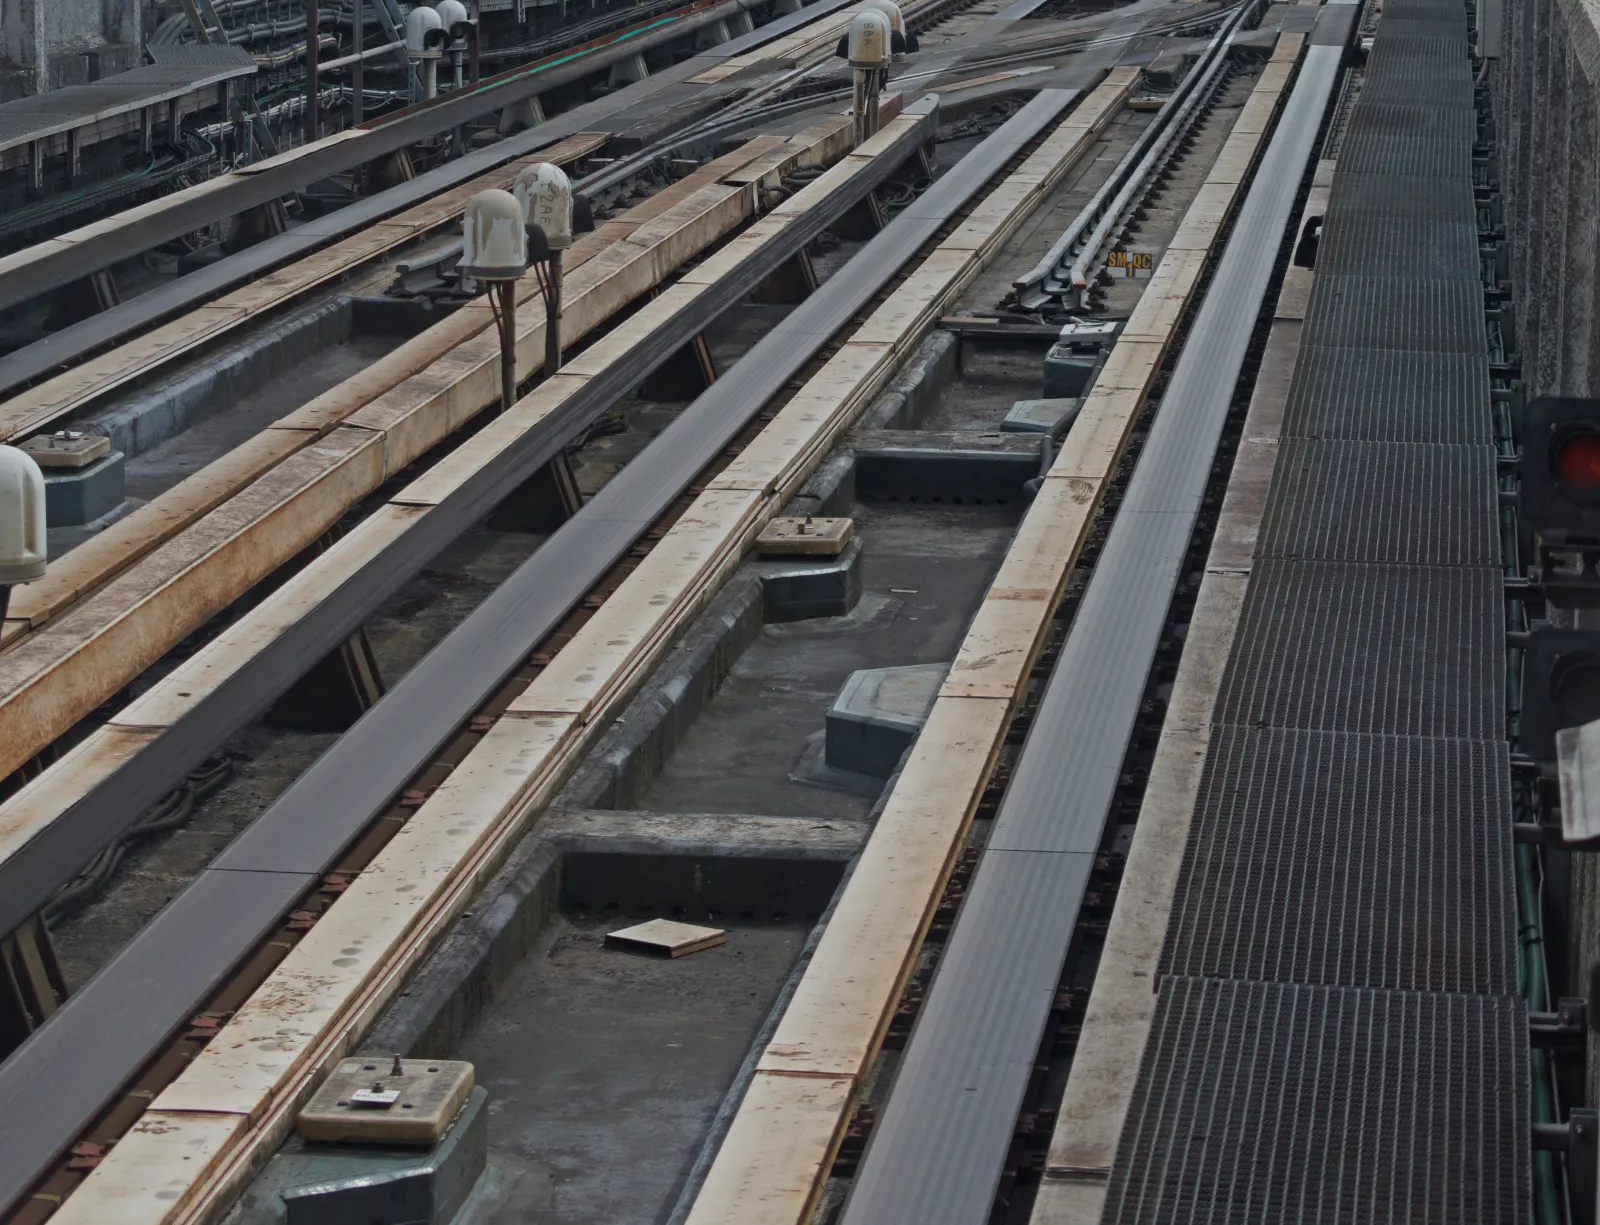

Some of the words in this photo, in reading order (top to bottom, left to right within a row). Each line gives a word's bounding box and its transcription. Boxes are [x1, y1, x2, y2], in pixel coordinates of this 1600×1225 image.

[1108, 251, 1127, 267] SM
[1127, 262, 1134, 277] 1
[1133, 253, 1152, 269] QC
